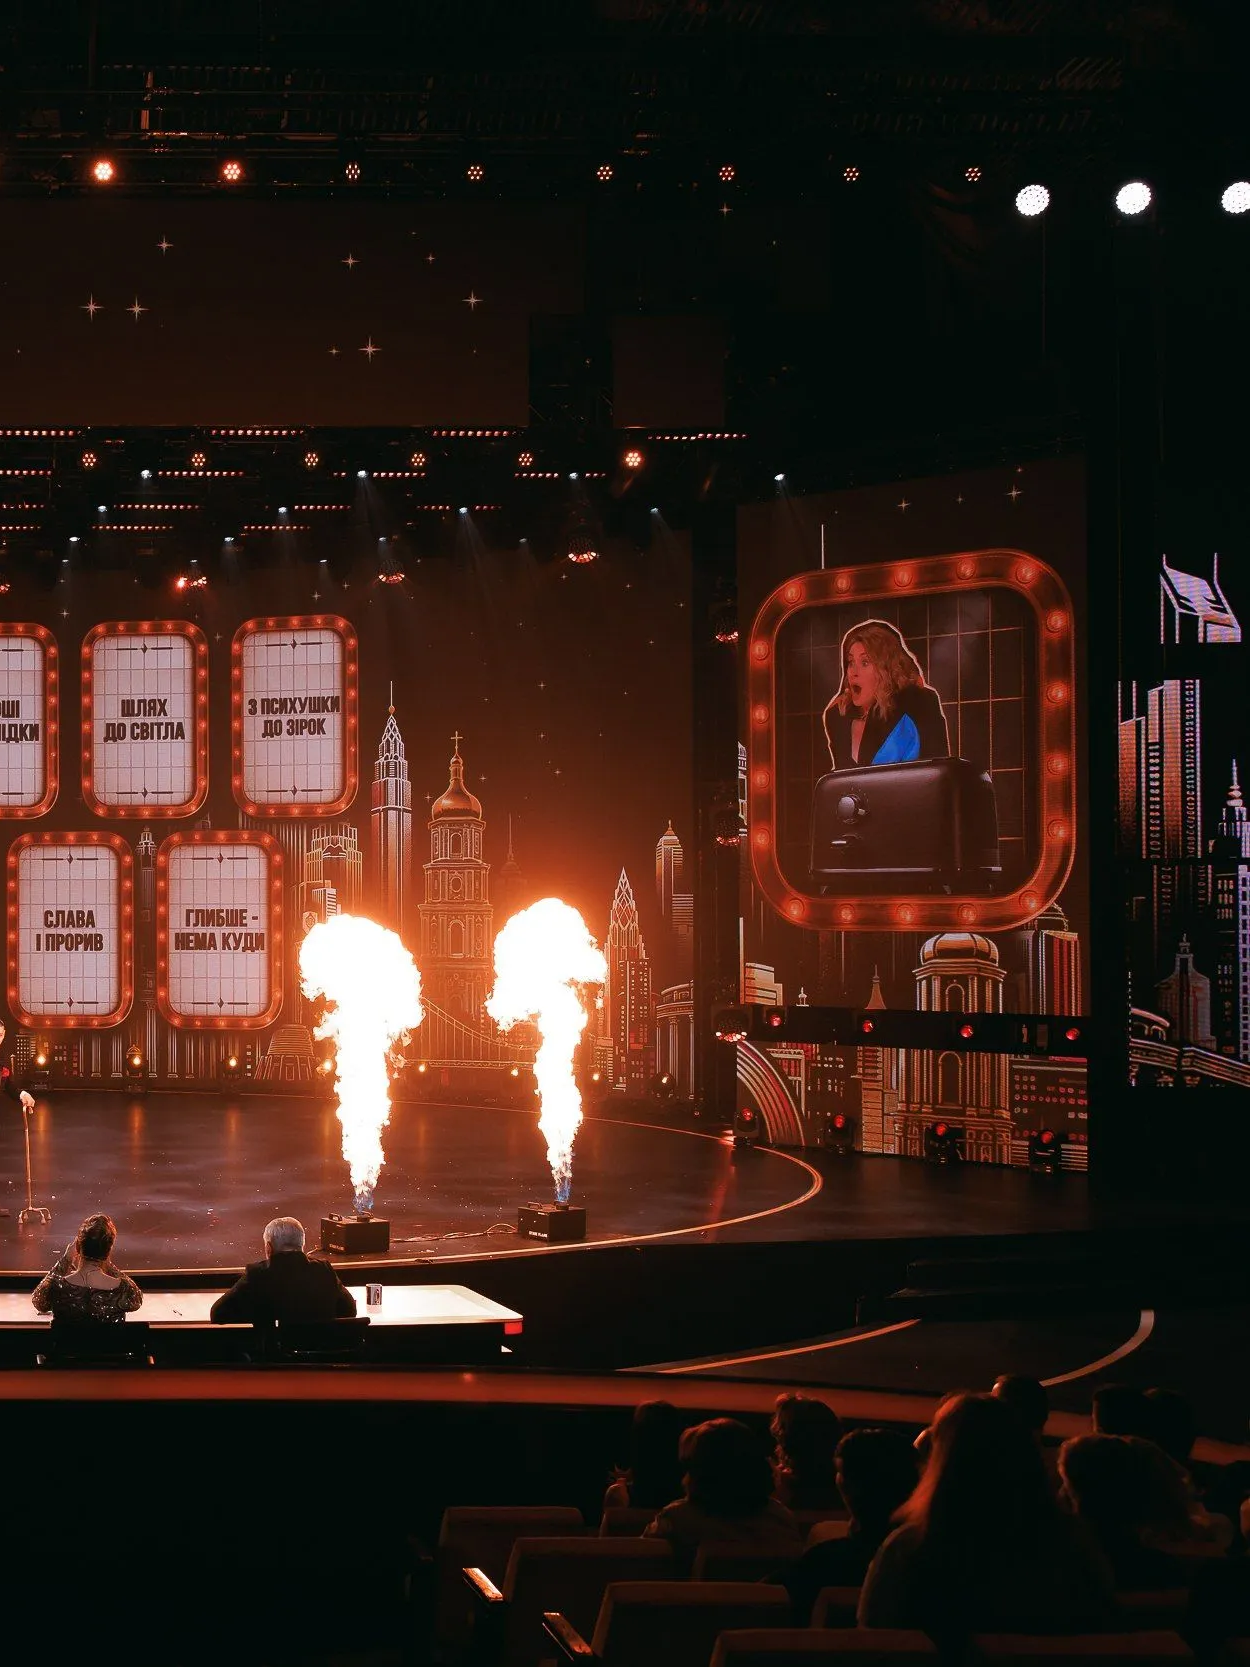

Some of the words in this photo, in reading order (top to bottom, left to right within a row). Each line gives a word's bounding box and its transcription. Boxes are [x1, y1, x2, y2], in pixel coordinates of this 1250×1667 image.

[121, 698, 168, 718] ШЛЯХ
[247, 699, 258, 716] З
[261, 695, 340, 716] ПСИХУШКИ
[103, 722, 127, 743] ДО
[130, 721, 185, 741] СВІТЛА
[261, 719, 283, 739] ДО
[286, 718, 326, 737] ЗІРОК
[43, 909, 96, 929] СЛАВА
[185, 908, 248, 928] ГЛИБШЕ
[36, 933, 41, 952] І
[45, 933, 104, 952] ПРОРИВ
[174, 932, 218, 951] НЕМА
[221, 932, 265, 953] КУДИ
